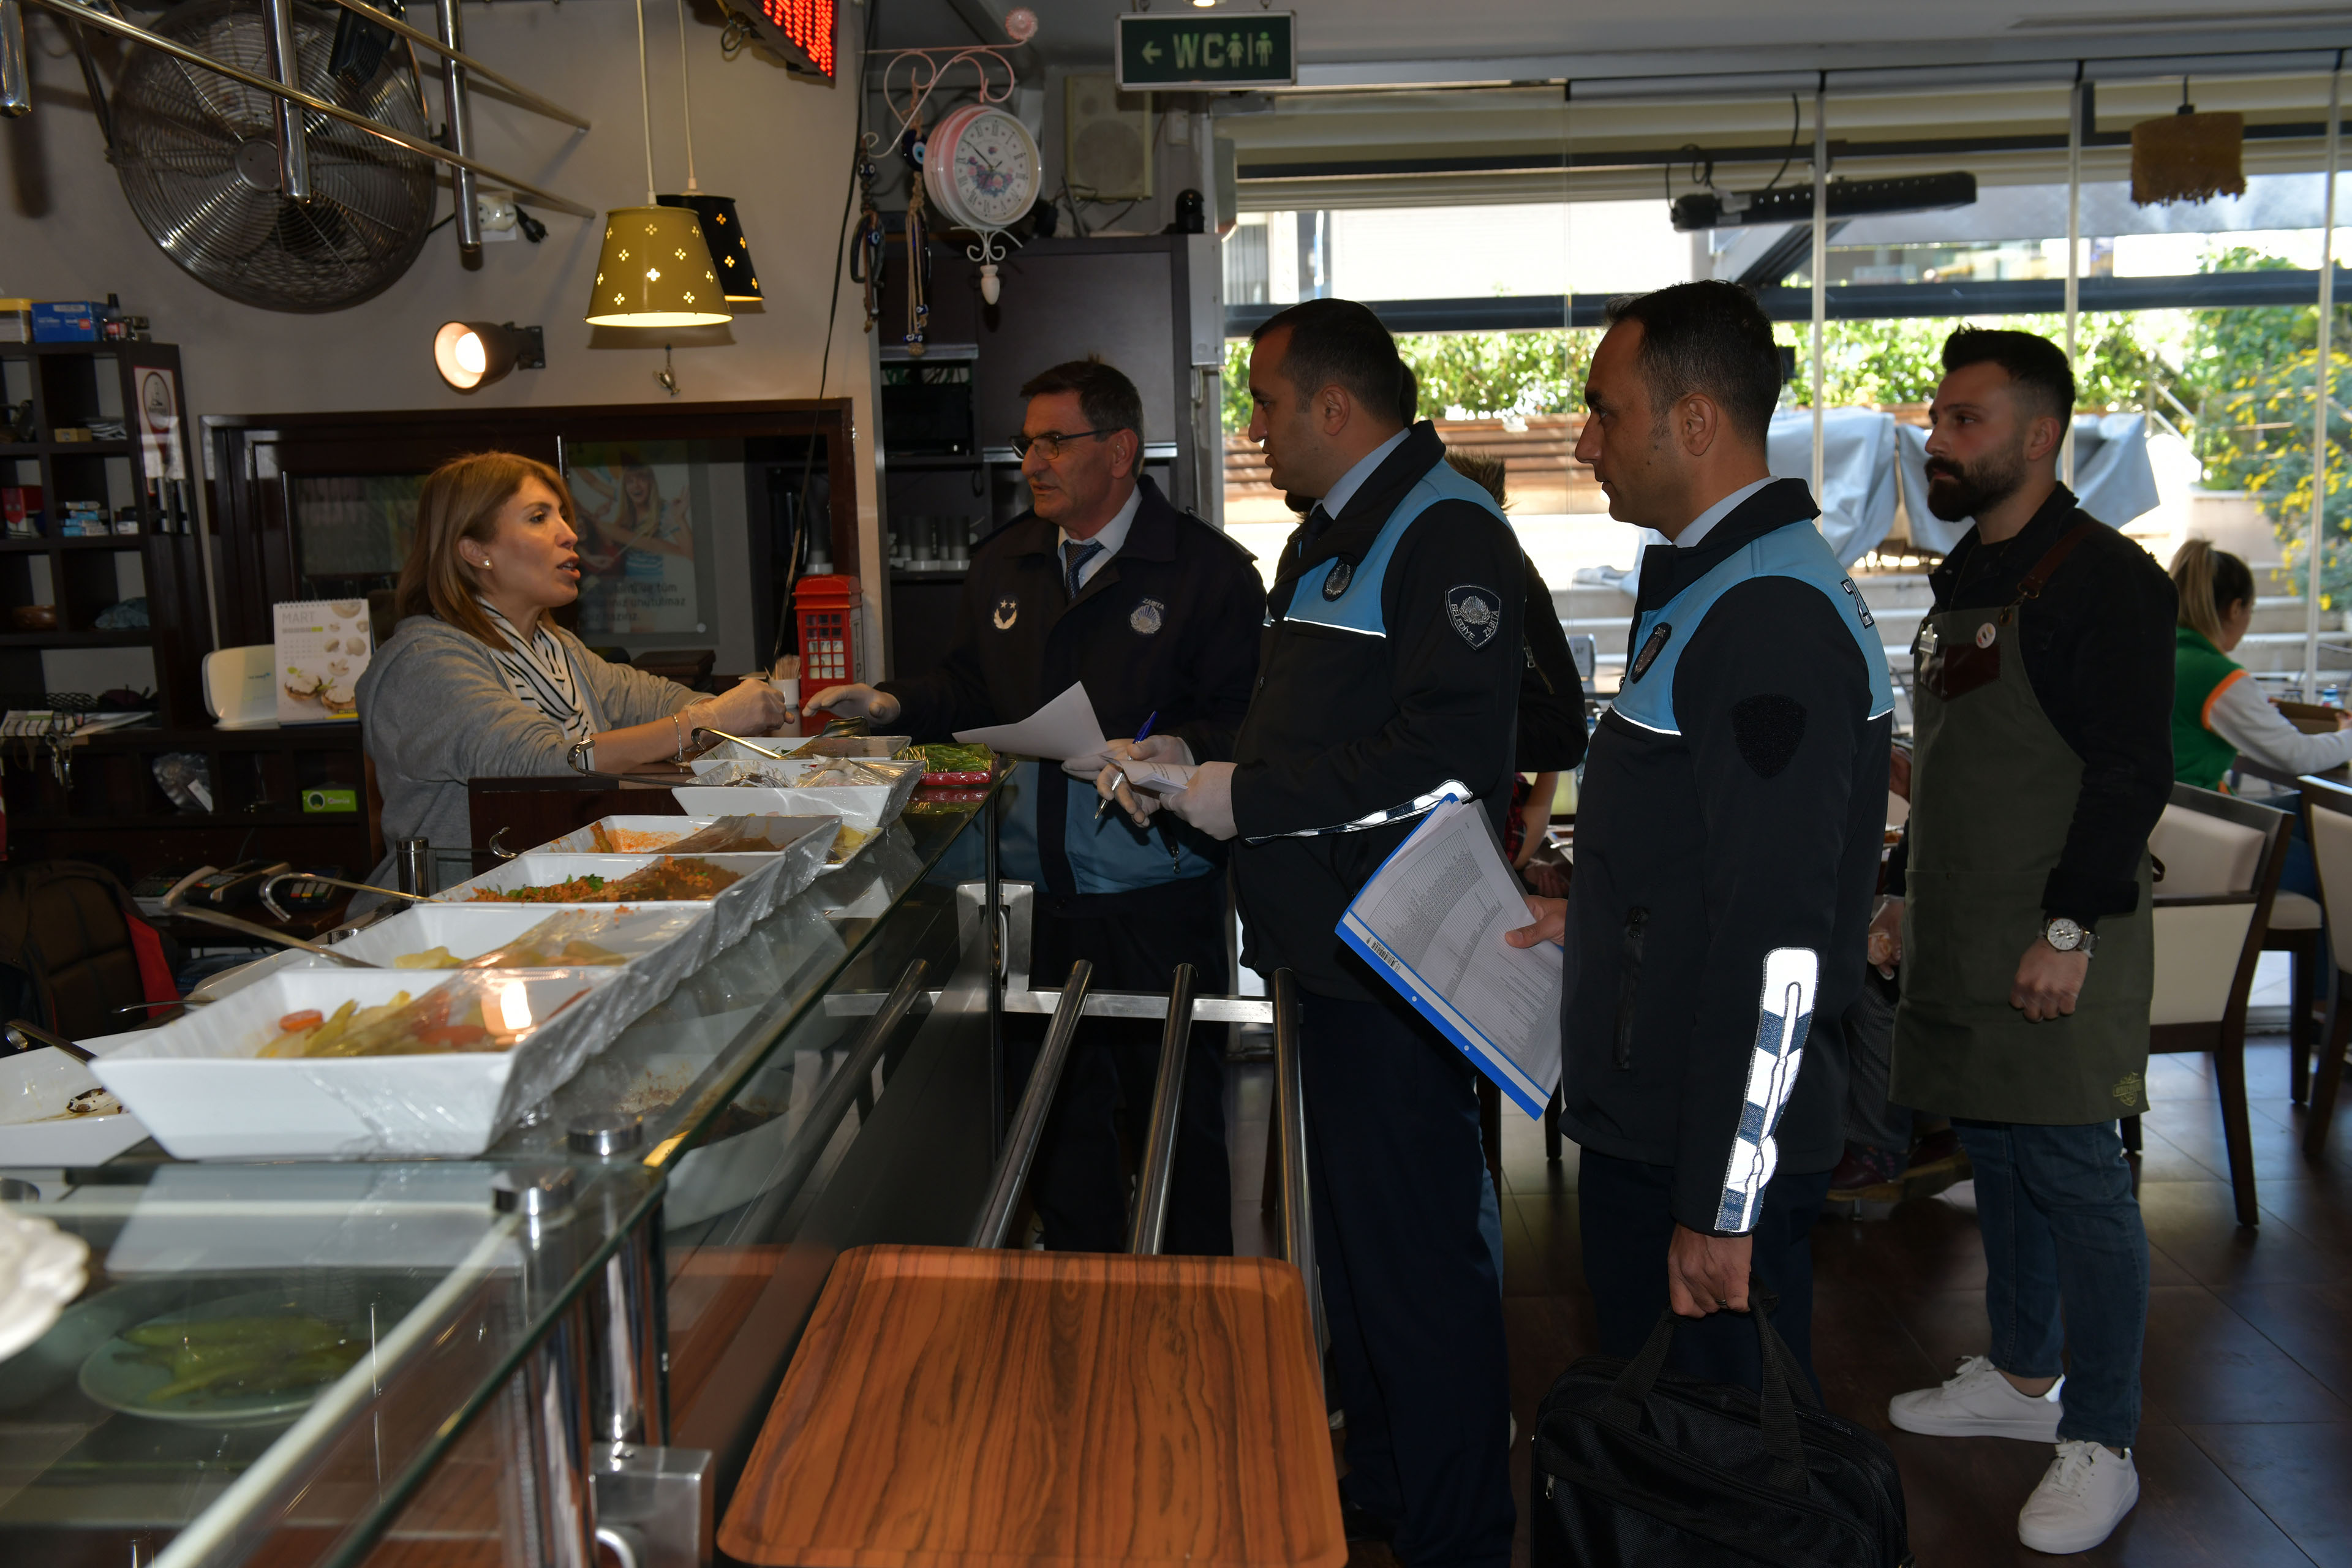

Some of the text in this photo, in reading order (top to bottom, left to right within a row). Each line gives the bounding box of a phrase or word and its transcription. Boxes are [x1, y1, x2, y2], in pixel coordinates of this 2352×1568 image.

[1172, 32, 1225, 69] WC
[282, 611, 315, 624] MART
[1451, 604, 1475, 640] BELEDİYE
[1482, 611, 1499, 637] ZABITA
